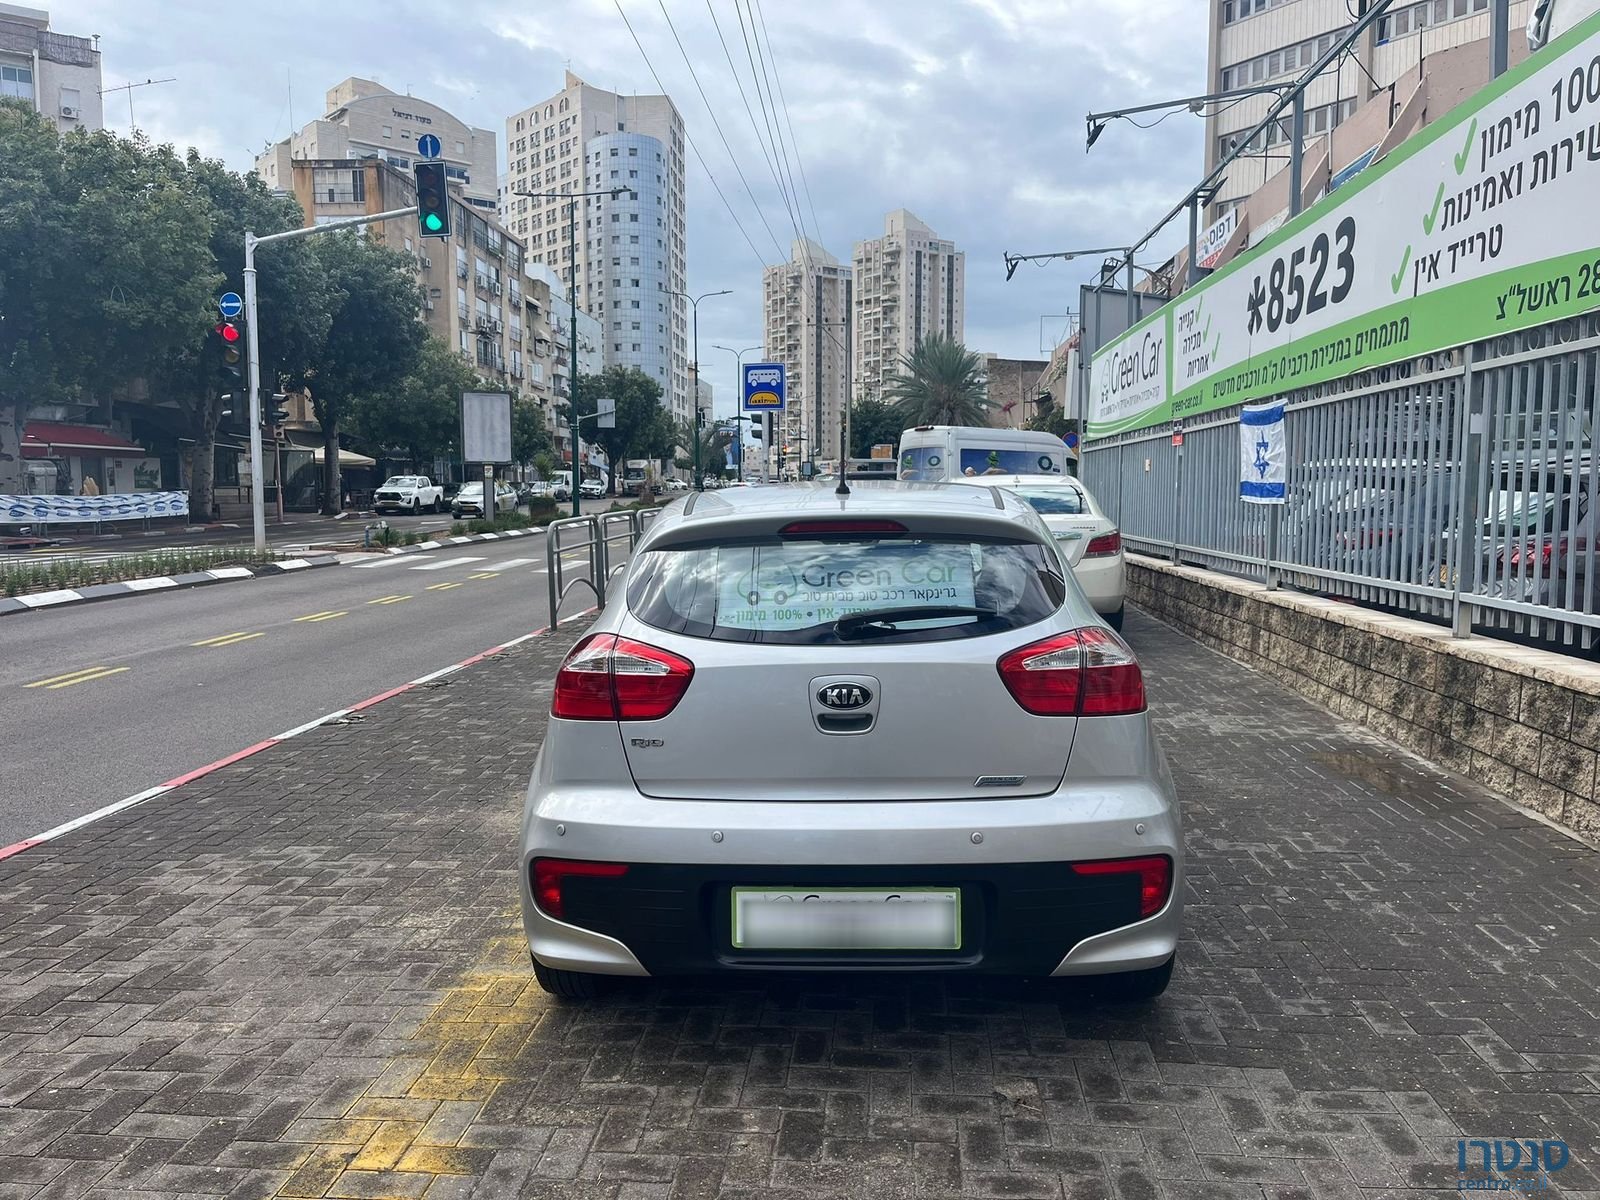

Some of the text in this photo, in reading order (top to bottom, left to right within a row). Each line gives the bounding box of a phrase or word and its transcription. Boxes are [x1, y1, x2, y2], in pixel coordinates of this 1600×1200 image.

[1480, 99, 1541, 173] מימון
[1441, 161, 1523, 231] ואמינות
[1413, 223, 1503, 297] טרייד אין
[1182, 331, 1202, 356] מכירה
[1354, 315, 1410, 356] מתמחים
[1111, 331, 1163, 395] Green Car
[1288, 353, 1308, 377] רכבי
[1311, 335, 1351, 370] במכירת
[1186, 353, 1210, 379] אחריות
[1236, 366, 1261, 390] ורכבים
[1279, 356, 1287, 379] 0
[1212, 376, 1235, 398] חדשים
[801, 560, 957, 587] Green Car
[802, 587, 957, 601] גרינקאר רכב טוב מבית טוב
[735, 610, 766, 624] מימון
[773, 609, 802, 622] 100%
[826, 688, 864, 705] KIA
